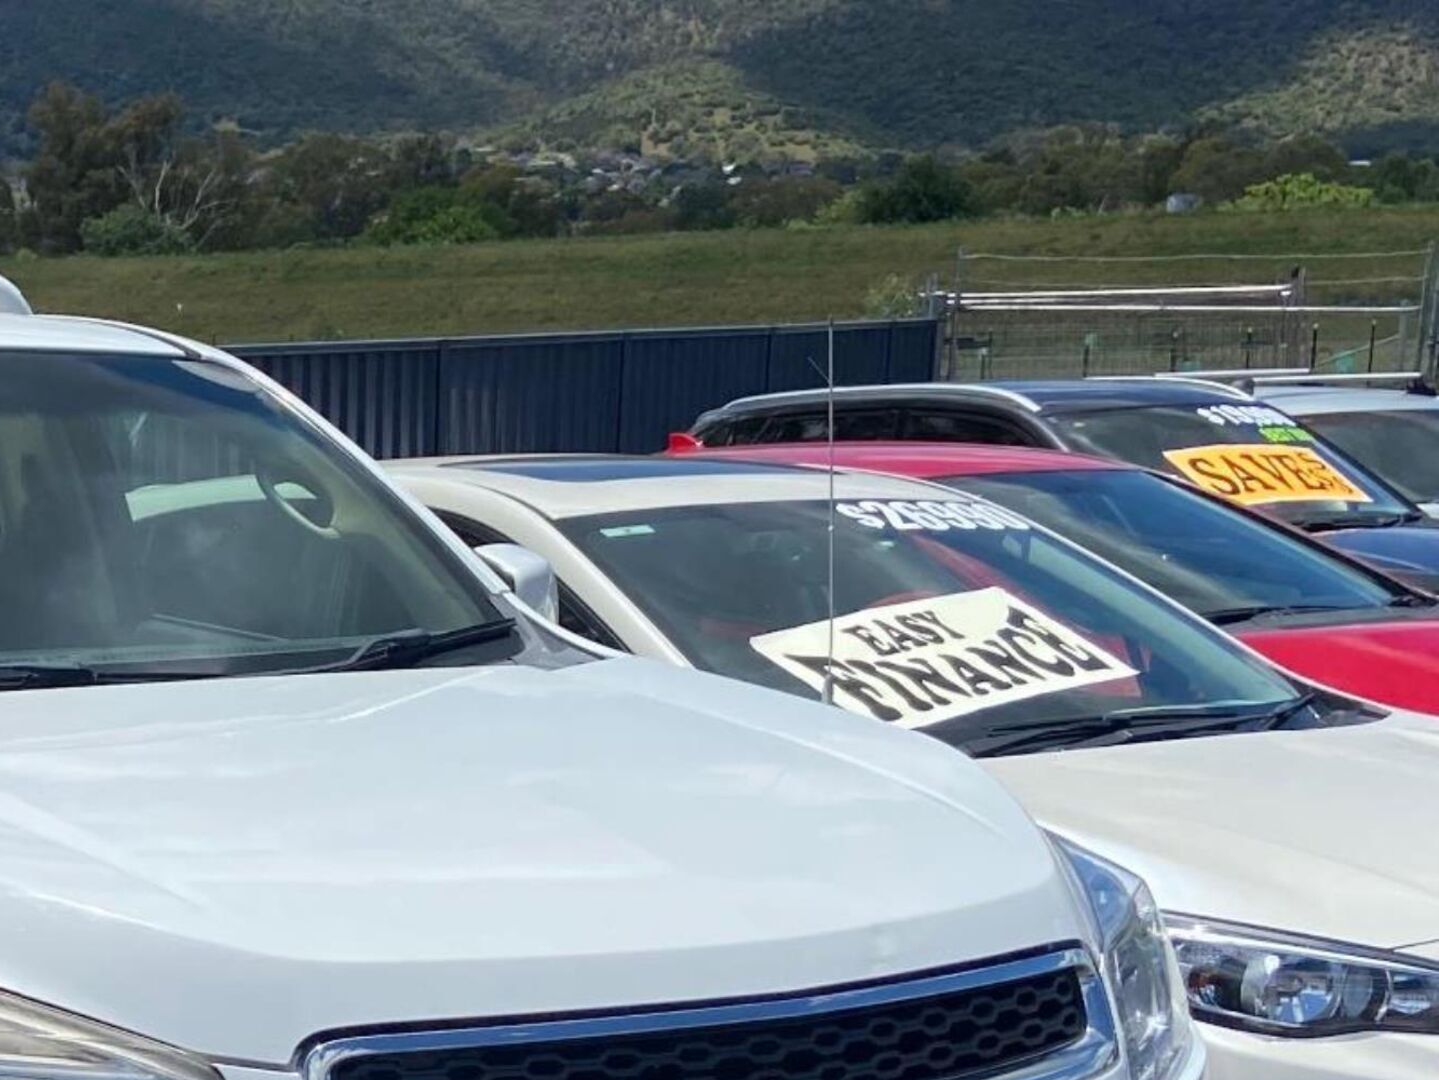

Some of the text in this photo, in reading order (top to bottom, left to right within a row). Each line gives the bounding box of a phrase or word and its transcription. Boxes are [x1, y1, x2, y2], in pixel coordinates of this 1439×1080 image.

[835, 501, 1031, 531] $26990
[841, 611, 964, 656] EASY
[784, 606, 1112, 722] FINANCE
